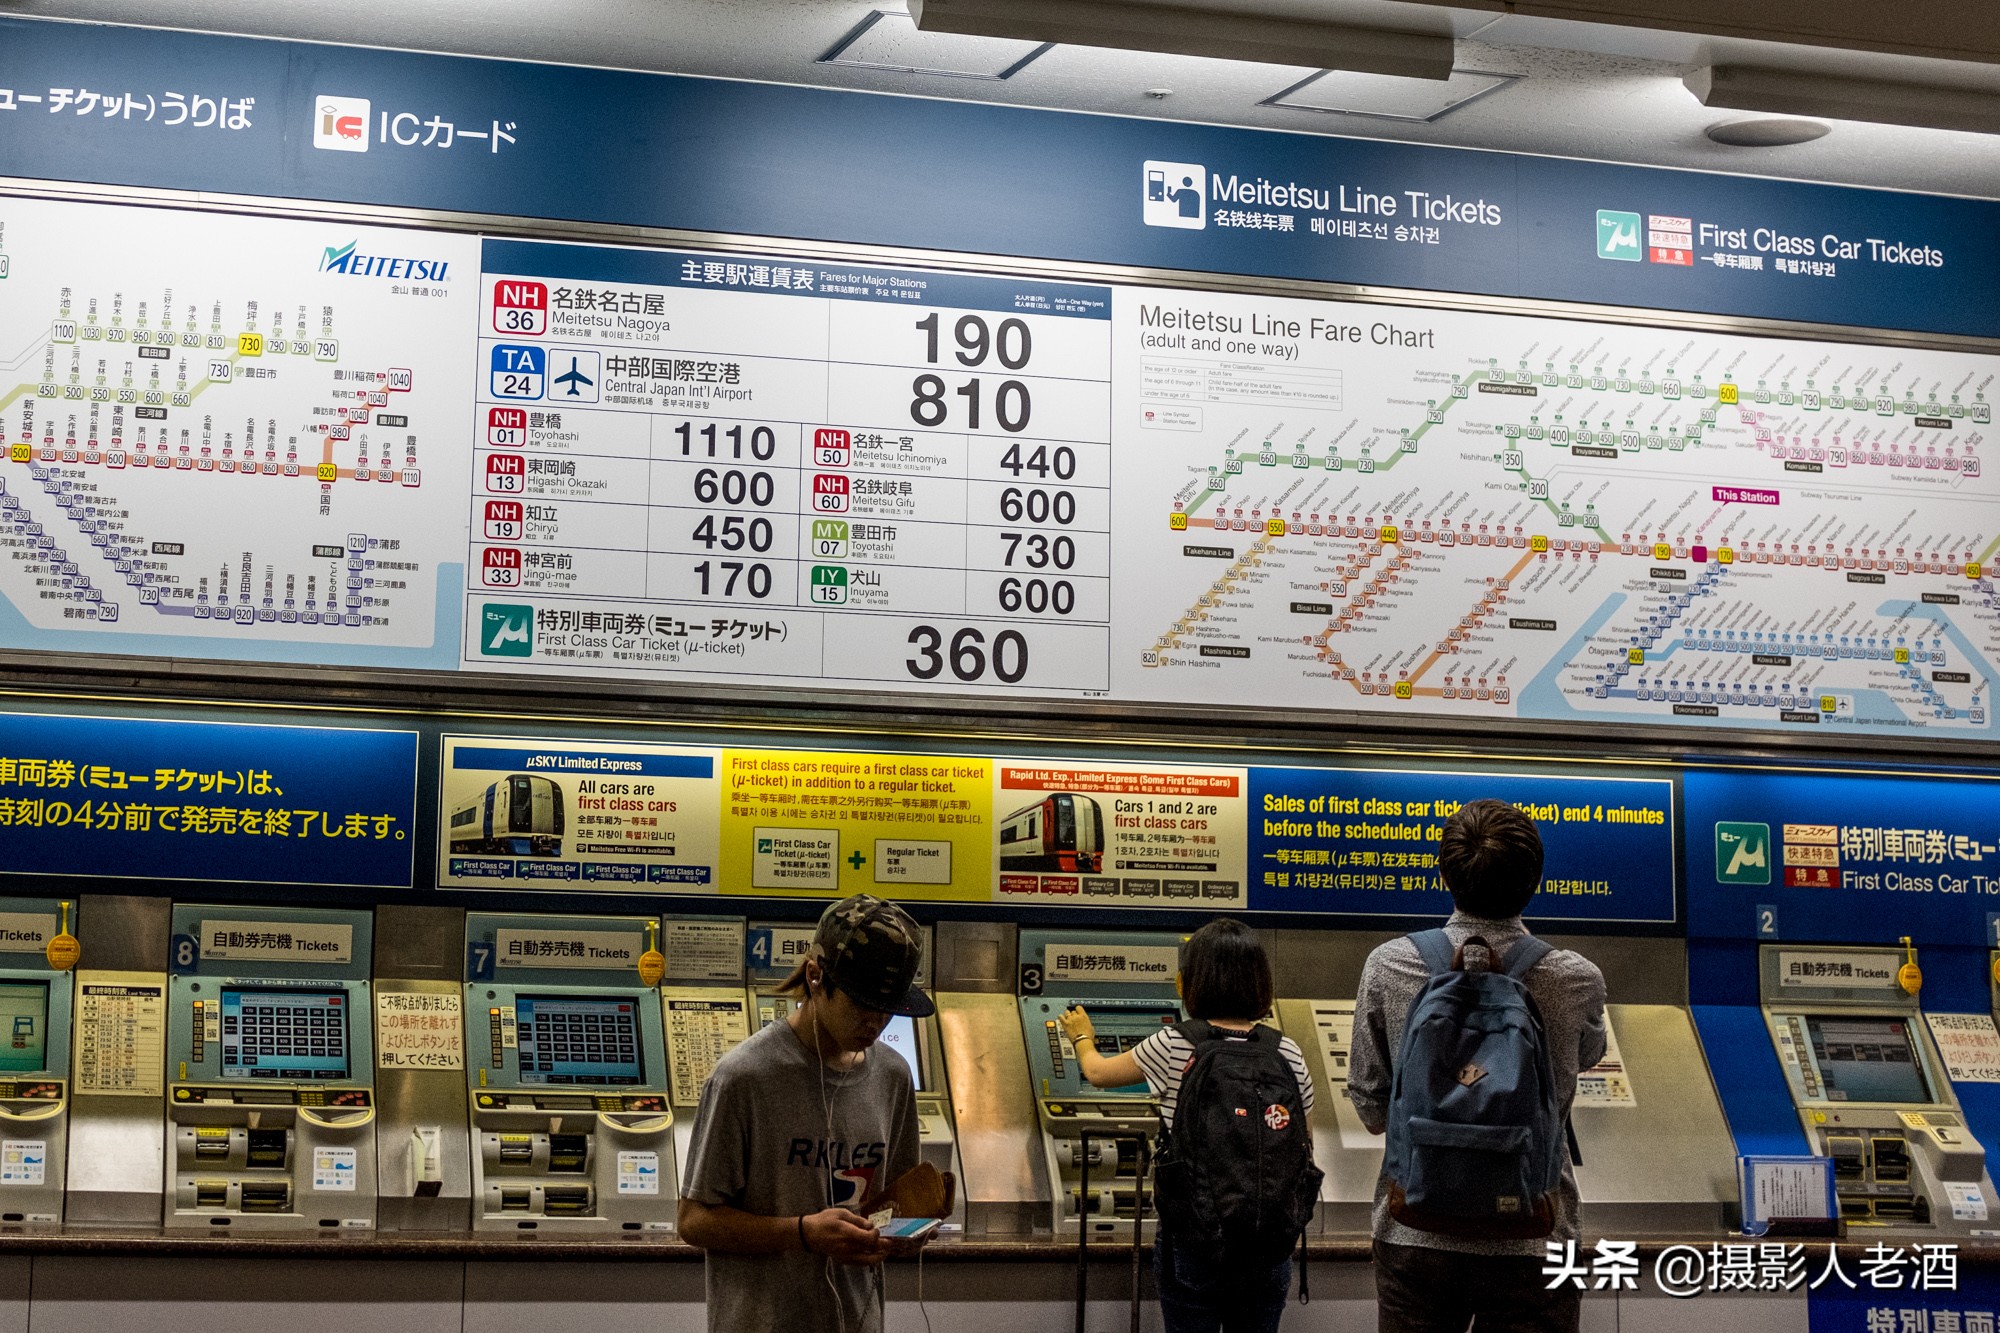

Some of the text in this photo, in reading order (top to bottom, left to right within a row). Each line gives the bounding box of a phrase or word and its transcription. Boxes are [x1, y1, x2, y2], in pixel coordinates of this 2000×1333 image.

[380, 111, 517, 154] ICカード
[1212, 173, 1502, 226] Meitetsu Line Tickets
[1213, 209, 1440, 245] 名铁线车票 메이테츠선 승차권
[1700, 223, 1943, 267] First Class Car Tickets
[318, 239, 448, 281] MEITETSU
[1701, 252, 1836, 277] 一等车厢票 특별차량권
[680, 259, 927, 291] 主要駅運賃表 Fares for Major Stations
[391, 284, 449, 299] 金山 普通 001
[502, 286, 539, 307] NH
[551, 287, 666, 317] 名鉄名古屋
[54, 323, 75, 339] 1100
[506, 310, 534, 331] 36
[552, 312, 671, 333] Meitetsu Nagoya
[1140, 304, 1434, 349] Meitetsu Line Fare Chart
[241, 337, 260, 351] 730
[916, 312, 1032, 370] 190
[1140, 331, 1300, 361] (adult and one way)
[502, 351, 535, 371] TA
[605, 355, 741, 385] 中部国際空港
[245, 367, 277, 379] 豊田市
[334, 369, 376, 382] 豊川稲荷
[503, 376, 532, 396] 24
[605, 378, 753, 402] Central Japan Int'l Airport
[1720, 388, 1736, 400] 600
[910, 373, 1032, 433] 810
[529, 412, 561, 430] 豊橋
[529, 429, 580, 442] Toyohashi
[674, 421, 776, 461] 1110
[853, 434, 915, 452] 名鉄一宮
[528, 458, 577, 477] 東岡崎
[853, 450, 948, 465] Meitetsu Ichinomiya
[1000, 443, 1076, 480] 440
[527, 476, 608, 490] Higashi Okazaki
[693, 468, 775, 507] 600
[852, 480, 914, 496] 名鉄岐阜
[852, 496, 916, 509] Meitetsu Gifu
[1000, 487, 1076, 525] 600
[1716, 489, 1777, 504] This Station
[525, 504, 558, 523] 知立
[692, 515, 773, 553] 450
[851, 524, 897, 541] 豊田市
[851, 541, 894, 553] Toyotashi
[1000, 532, 1076, 570] 730
[523, 551, 573, 570] 神宮前
[693, 560, 773, 599] 170
[850, 569, 881, 587] 犬山
[172, 587, 194, 599] 西尾
[850, 588, 889, 599] Inuyama
[998, 577, 1075, 615] 600
[537, 632, 680, 652] First Class Car Ticket
[905, 624, 1029, 684] 360
[1169, 658, 1221, 668] Shin Hashima
[558, 757, 599, 770] Limited
[600, 758, 643, 772] Express
[732, 758, 985, 779] First class cars require first class car ticket
[578, 779, 655, 796] All cars are
[577, 796, 677, 813] first class cars
[1263, 793, 1664, 825] Sales of first class car end 4 minutes
[1263, 819, 1312, 838] before
[1316, 820, 1340, 839] the
[1344, 821, 1422, 841] scheduled
[1840, 825, 2000, 864] 特別車両券(ミュー
[1843, 870, 2000, 895] First Class Car Tic
[1761, 910, 1774, 933] 2
[0, 929, 42, 942] Tickets
[213, 931, 339, 952] 自動券売機 Tickets
[177, 940, 194, 966] 8
[508, 940, 630, 959] 自動券売機 Tickets
[752, 936, 767, 959] 4
[474, 948, 489, 973] 7
[1056, 954, 1168, 972] 自動券売機 Tickets
[1789, 961, 1890, 980] 自動券売機 Tickets
[1023, 969, 1041, 989] 3
[380, 1014, 459, 1030] この場所を離れず
[381, 1051, 460, 1067] 押してください
[1866, 1306, 2000, 1333] 特別車両
